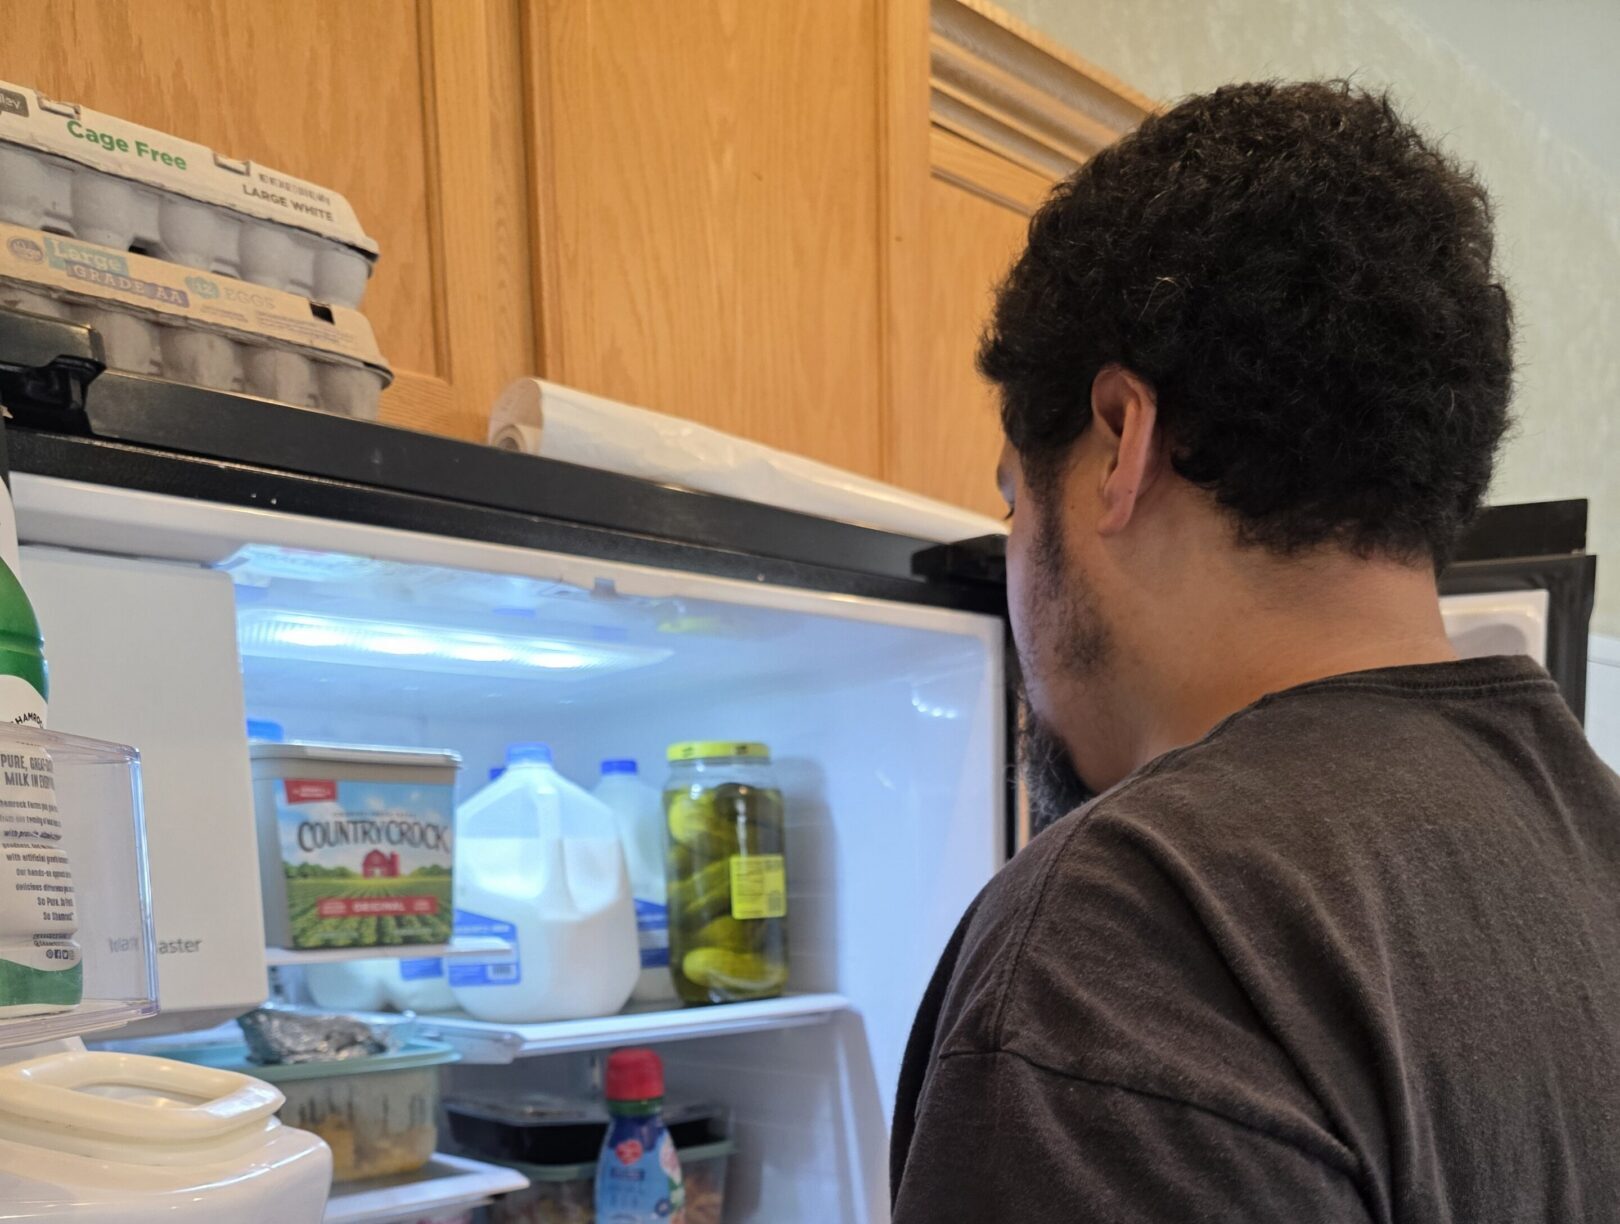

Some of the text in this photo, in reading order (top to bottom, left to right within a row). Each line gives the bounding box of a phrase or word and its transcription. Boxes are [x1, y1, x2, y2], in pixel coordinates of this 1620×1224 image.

[67, 120, 187, 170] Cage Free
[242, 184, 289, 208] LARGE
[290, 200, 334, 222] WHITE
[52, 239, 122, 271] Large
[73, 264, 183, 304] GRADE AA
[0, 753, 28, 771] PURE,
[5, 771, 30, 787] MILK
[31, 773, 39, 788] IN
[298, 820, 451, 854] COUNTRY CROCK
